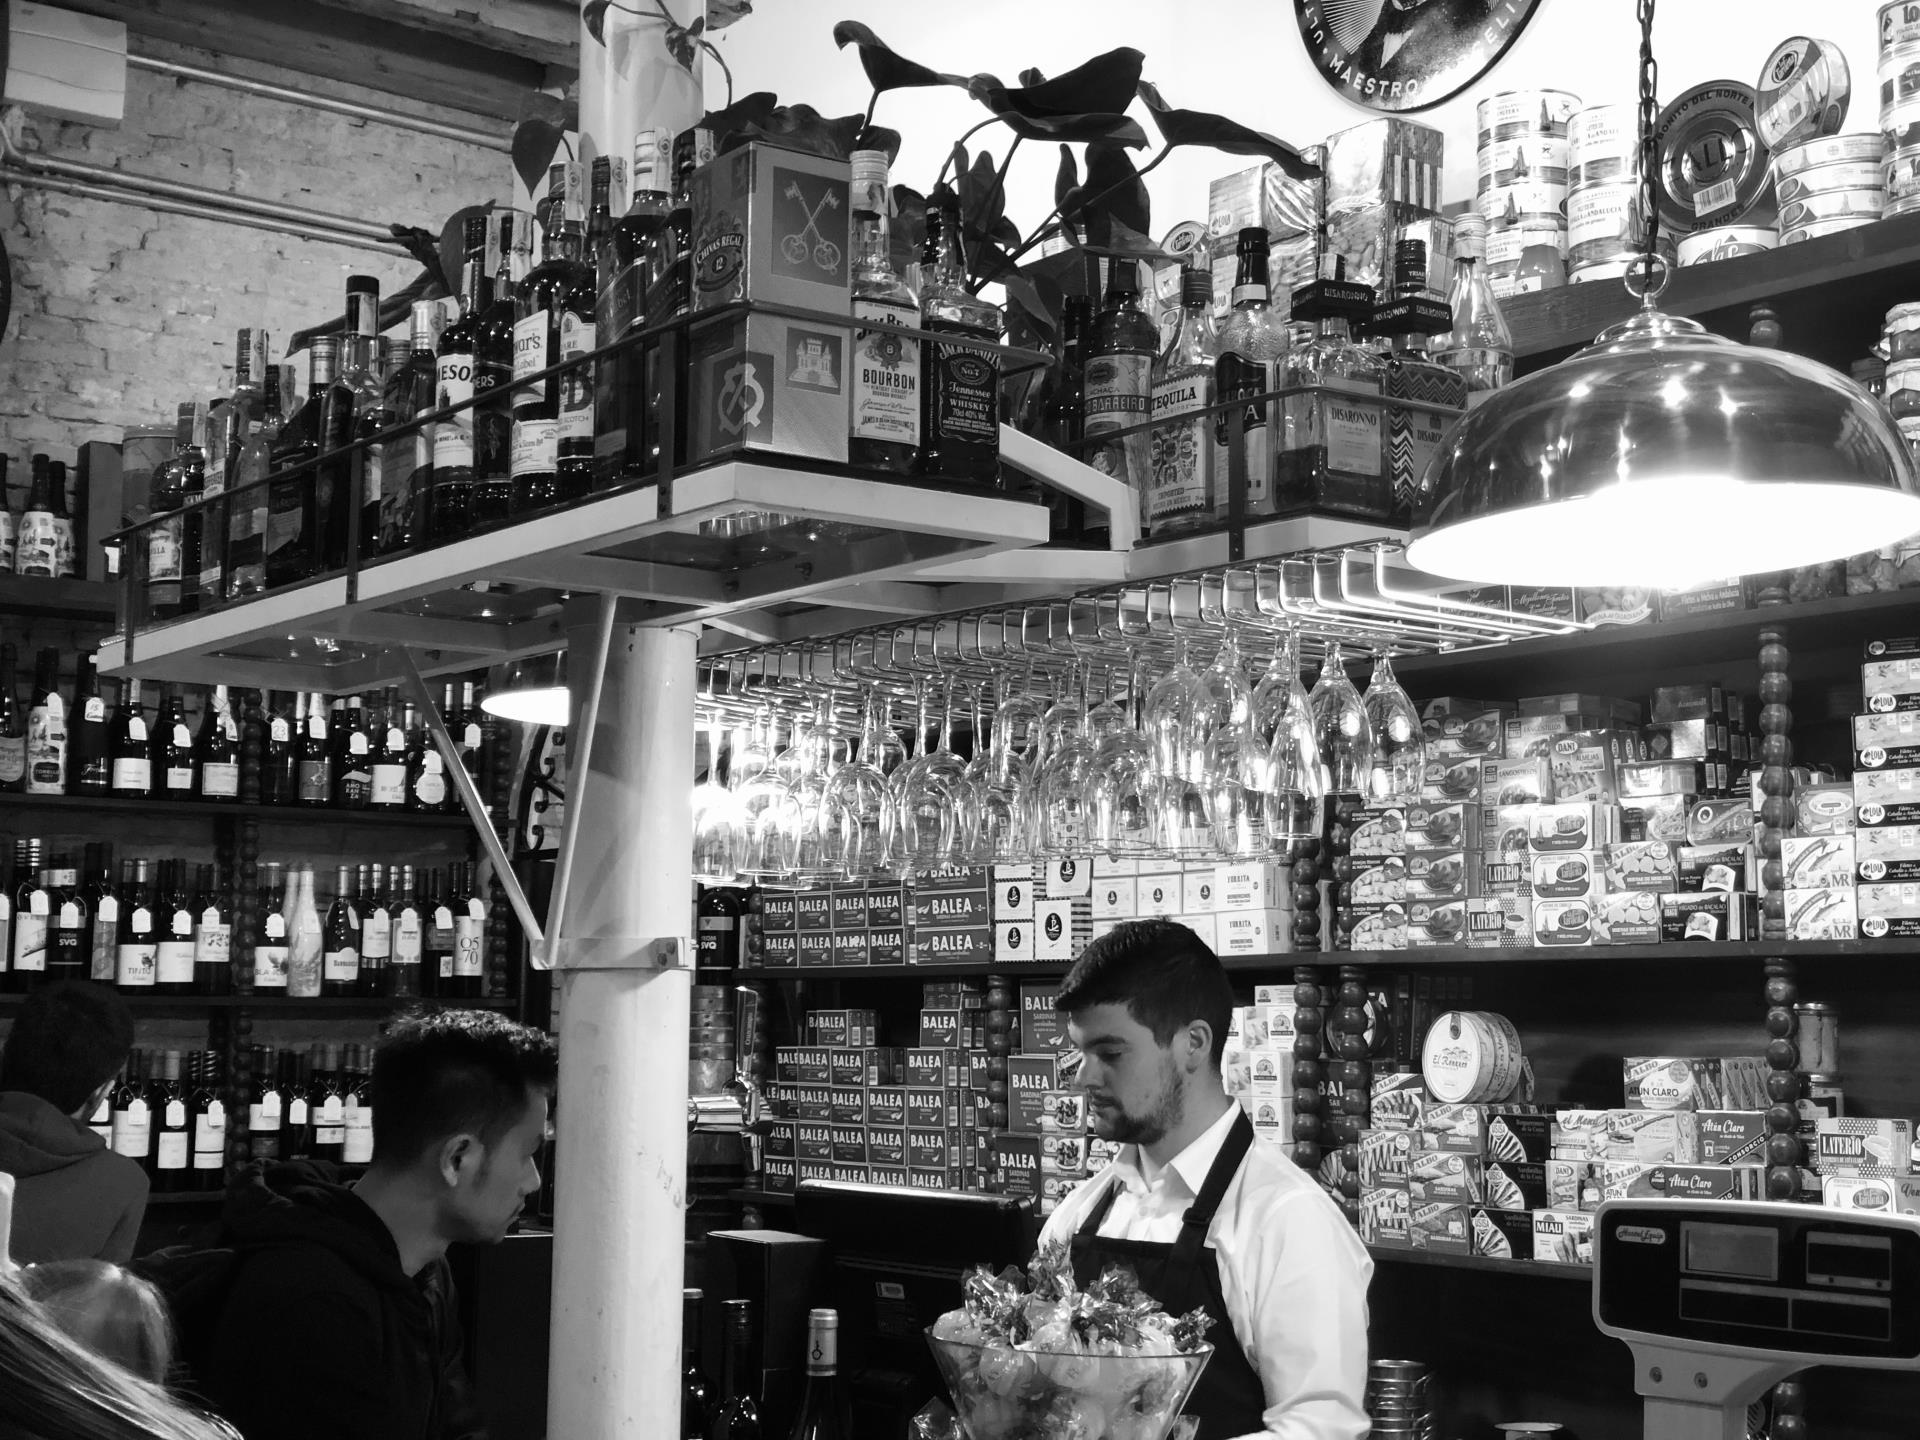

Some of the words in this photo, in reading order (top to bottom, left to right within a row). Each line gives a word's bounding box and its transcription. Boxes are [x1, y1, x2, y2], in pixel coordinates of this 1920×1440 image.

[1330, 53, 1417, 97] MAESTRO
[1657, 104, 1688, 141] BONITO
[1692, 93, 1713, 106] DEL
[1715, 88, 1749, 105] NORTE
[1691, 203, 1745, 231] GRANDES
[697, 236, 721, 265] CHIVAS
[721, 232, 743, 248] REGAL
[714, 257, 724, 270] 12
[1324, 287, 1369, 302] DISARONNO
[1415, 304, 1450, 320] DISARONNO
[863, 368, 915, 391] BOURBON
[949, 381, 991, 399] Tennessee
[949, 398, 990, 412] WHISKEY
[1151, 386, 1197, 410] TEQUILA
[1331, 407, 1377, 426] DISARONNO
[1417, 429, 1443, 443] DISARO
[1880, 696, 1894, 707] LOLA
[1557, 741, 1576, 752] DANI
[1576, 754, 1600, 762] ALMEJAS
[1870, 750, 1883, 760] LOLA
[1500, 767, 1538, 779] LANGOSTILLOS
[1869, 806, 1882, 817] LOLA
[1870, 862, 1883, 873] LOLA
[1832, 874, 1850, 888] MR
[765, 901, 793, 914] BALEA
[799, 900, 828, 912] BALEA
[835, 897, 864, 911] BALEA
[869, 895, 899, 909] BALEA
[932, 897, 972, 914] BALEA
[1834, 925, 1852, 938] MR
[1872, 919, 1885, 930] LOLA
[59, 938, 77, 947] SVQ
[701, 940, 717, 949] SVQ
[766, 937, 795, 950] BALEA
[801, 936, 831, 949] BALEA
[871, 933, 901, 946] BALEA
[933, 934, 973, 951] BALEA
[462, 949, 478, 965] 70
[1025, 997, 1054, 1011] BALE
[819, 1016, 845, 1029] BALEA
[923, 1016, 956, 1029] BALEA
[778, 1052, 798, 1064] BALE
[799, 1053, 828, 1065] BALEA
[832, 1055, 861, 1067] BALEA
[909, 1055, 941, 1068] BALEA
[1634, 1060, 1659, 1079] ALBO
[1012, 1074, 1049, 1089] BALEA
[1377, 1075, 1400, 1091] ALBO
[780, 1088, 796, 1101] BAL
[800, 1090, 829, 1103] BALEA
[1629, 1086, 1650, 1097] ATUN
[1651, 1087, 1680, 1098] CLARO
[832, 1093, 861, 1107] BALEA
[869, 1094, 902, 1107] BALEA
[909, 1095, 942, 1108] BALEA
[1428, 1106, 1452, 1121] ALBO
[1616, 1114, 1644, 1131] ALBO
[1701, 1119, 1722, 1132] Atún
[1723, 1118, 1745, 1133] Claro
[800, 1128, 830, 1142] BALEA
[833, 1131, 863, 1144] BALEA
[870, 1133, 902, 1146] BALEA
[910, 1135, 943, 1148] BALEA
[1364, 1132, 1387, 1147] ALBO
[1727, 1135, 1766, 1165] CONSORCIO
[1000, 1153, 1036, 1169] BALEA
[1414, 1154, 1439, 1170] ALBO
[765, 1162, 793, 1176] BALEA
[801, 1165, 831, 1179] BALEA
[834, 1169, 866, 1183] BALEA
[1009, 1170, 1030, 1178] SARDINAS
[1556, 1167, 1571, 1176] DANI
[1612, 1164, 1642, 1182] ALBO
[872, 1171, 904, 1186] BALEA
[912, 1174, 943, 1189] BALEA
[1669, 1174, 1690, 1188] Atún
[1691, 1174, 1713, 1188] Claro
[1364, 1189, 1387, 1204] ALBO
[1605, 1188, 1623, 1198] ATUN
[1415, 1204, 1440, 1218] ALBO
[1535, 1223, 1562, 1233] MIAU
